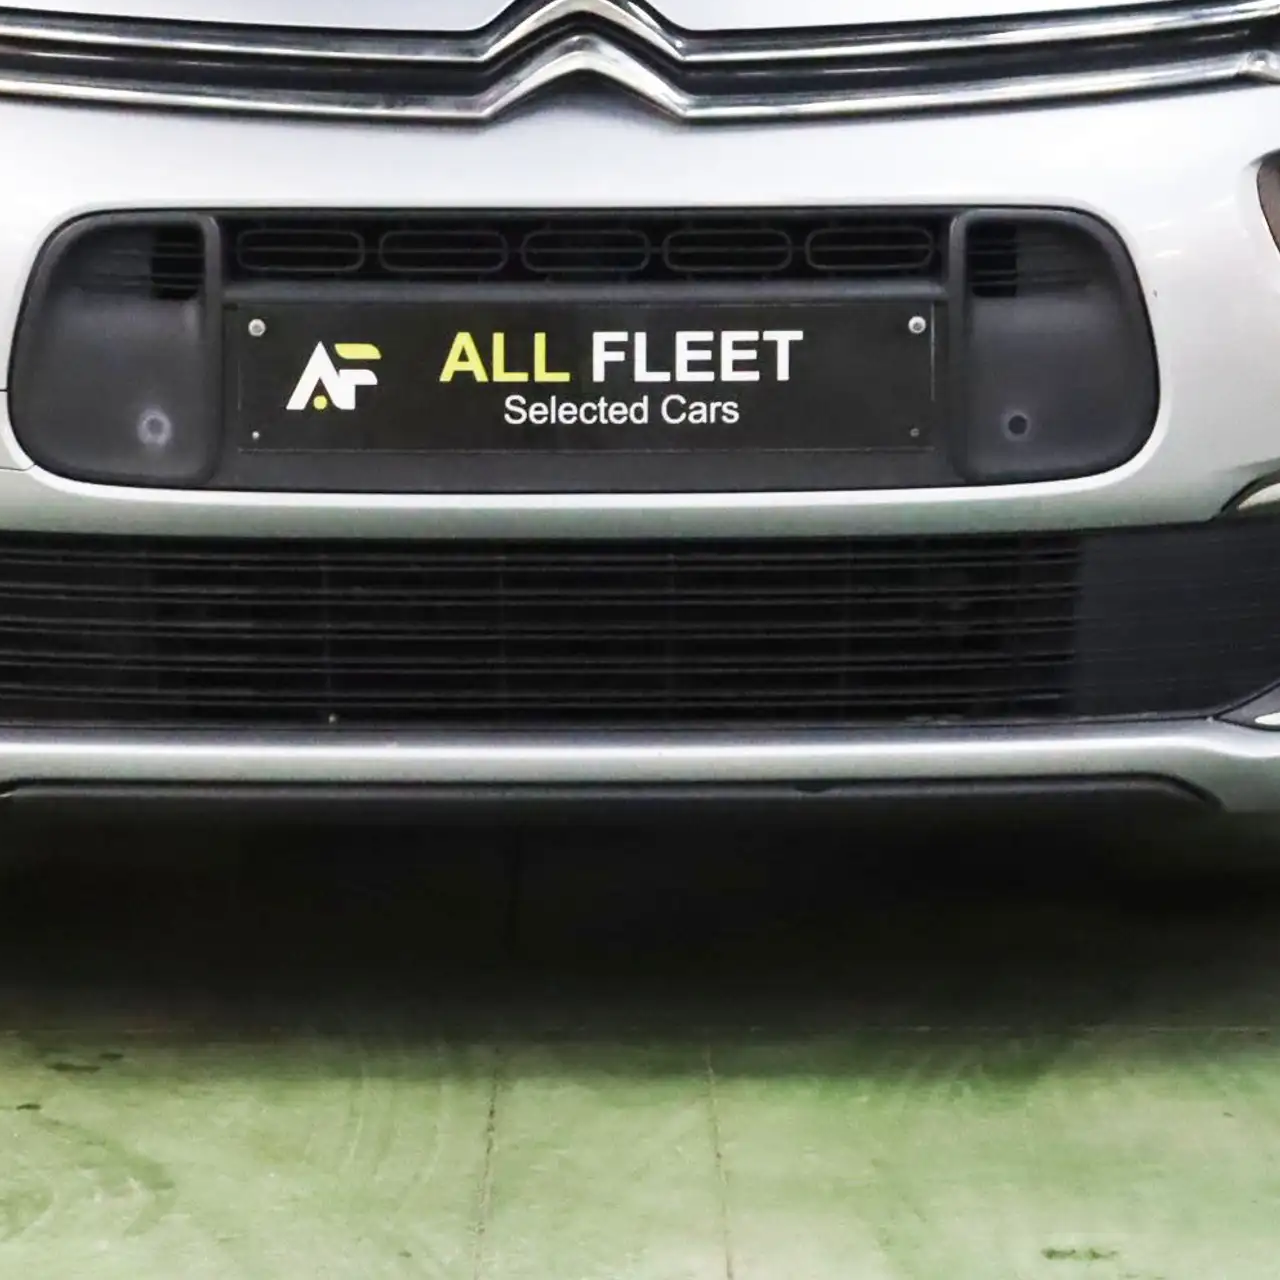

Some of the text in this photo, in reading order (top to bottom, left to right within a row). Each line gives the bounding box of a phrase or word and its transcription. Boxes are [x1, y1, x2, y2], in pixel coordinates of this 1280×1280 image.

[439, 330, 804, 382] ALL FLEET
[503, 395, 741, 425] Selected Cars
